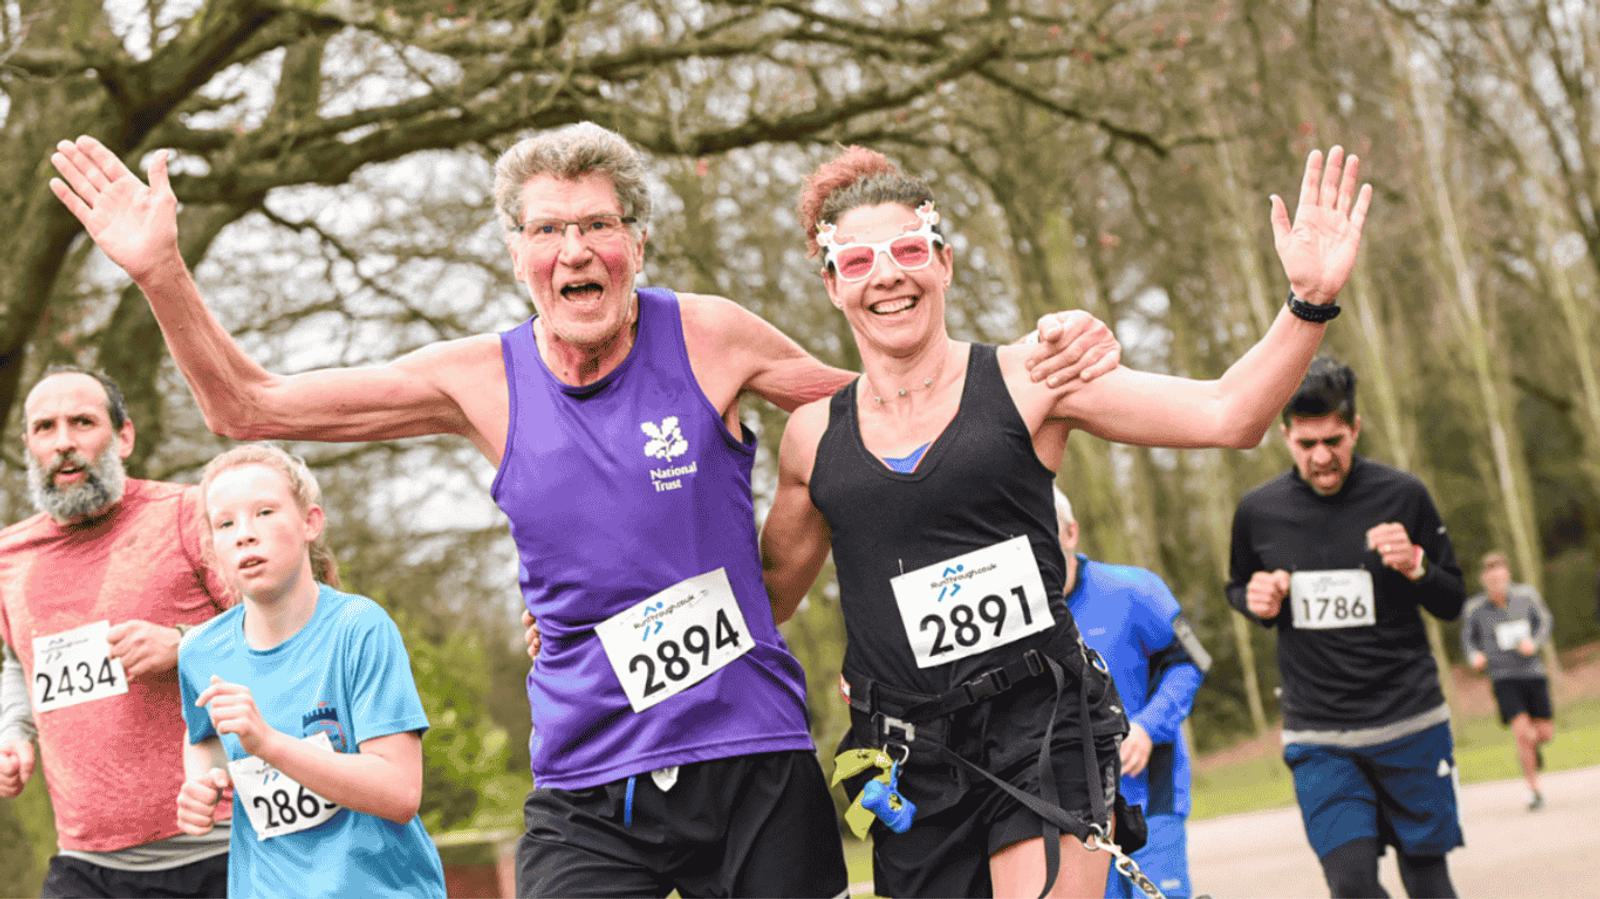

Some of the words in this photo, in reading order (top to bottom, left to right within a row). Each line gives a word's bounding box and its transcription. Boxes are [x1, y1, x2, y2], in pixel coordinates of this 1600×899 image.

[649, 461, 697, 480] National
[652, 479, 682, 492] Trust
[920, 585, 1033, 657] 2891
[1302, 595, 1367, 621] 1786
[629, 608, 739, 698] 2894
[36, 656, 117, 703] 2434
